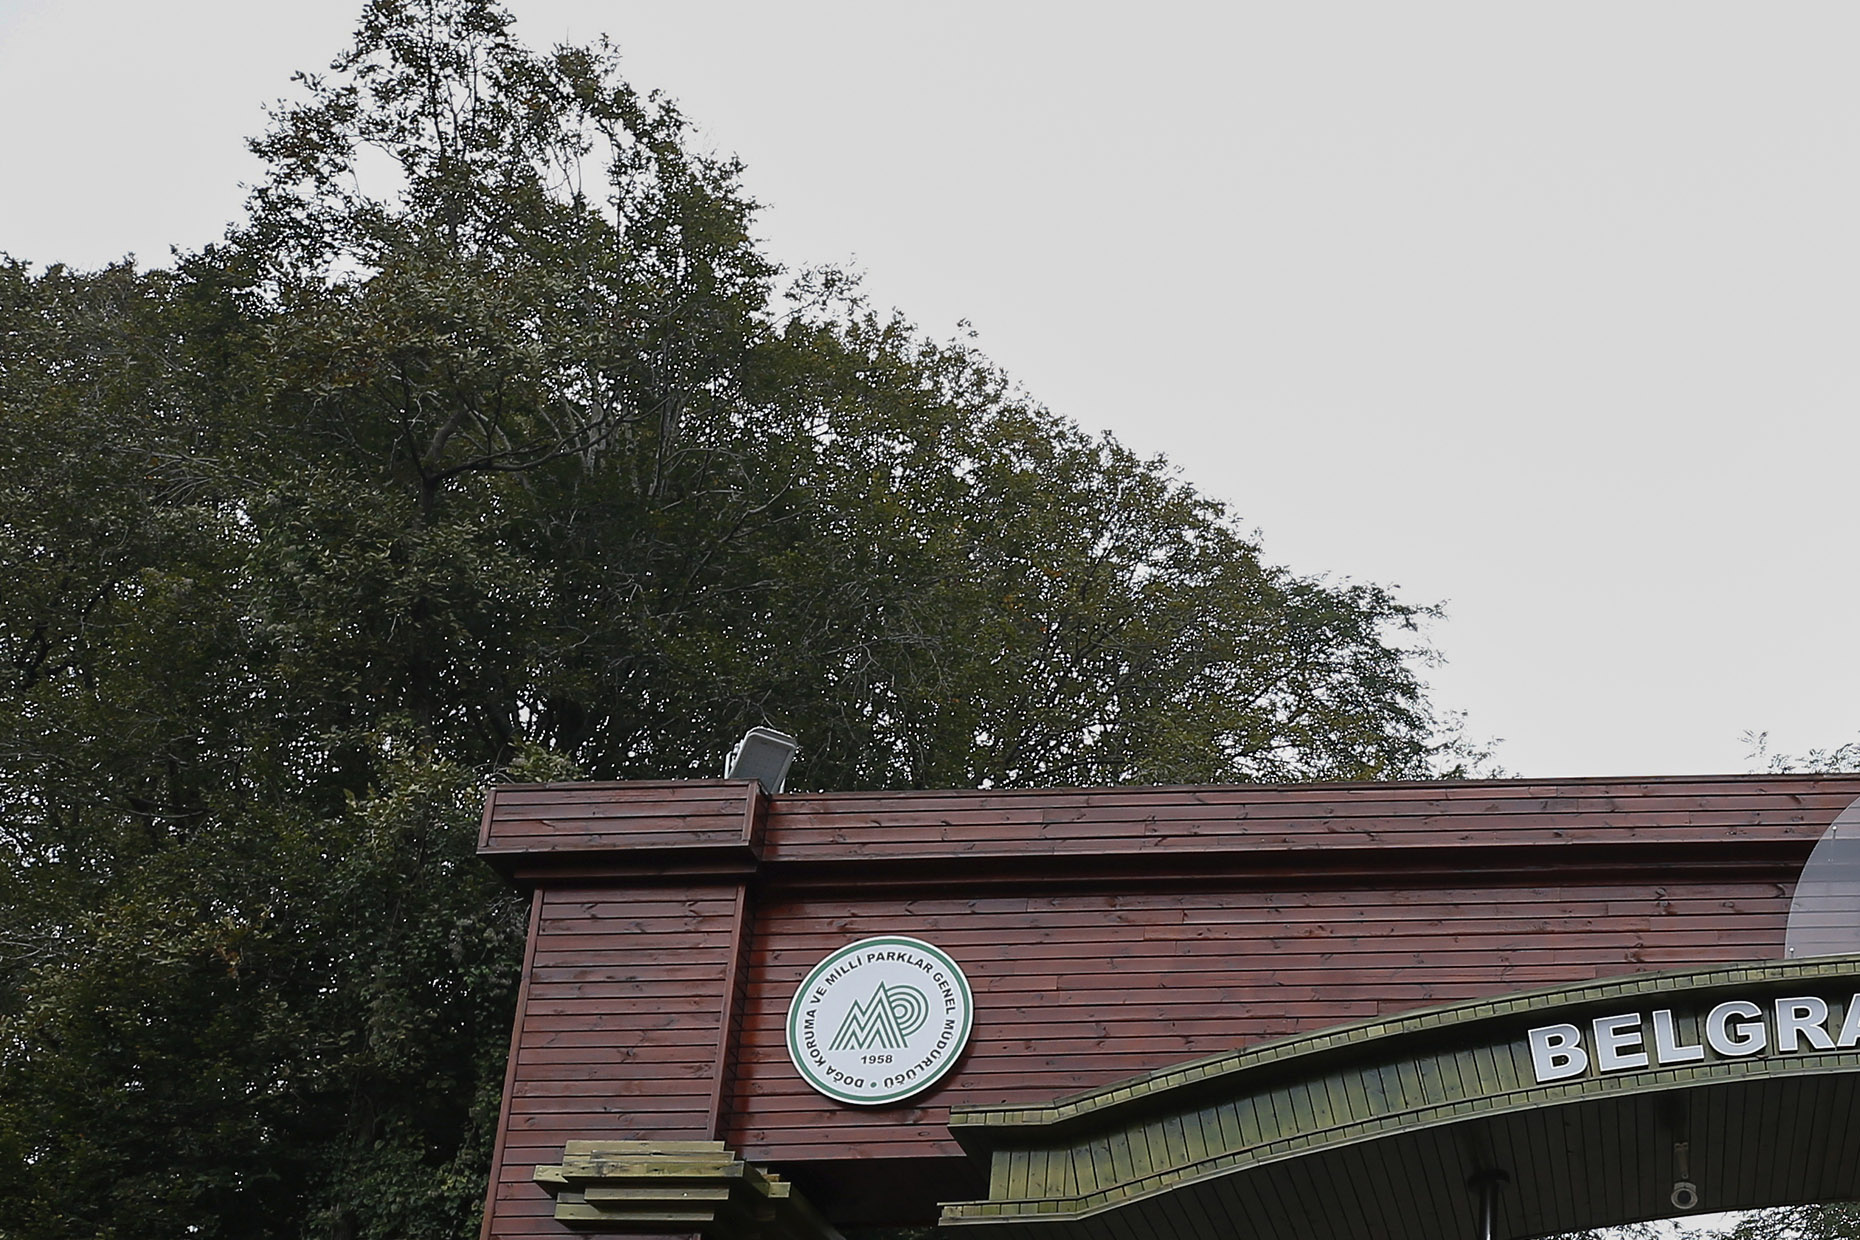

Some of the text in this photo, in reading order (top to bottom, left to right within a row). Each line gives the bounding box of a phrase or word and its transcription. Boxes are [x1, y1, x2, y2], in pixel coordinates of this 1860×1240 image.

[804, 951, 957, 1089] DOĞA KORUMA VE MİLLİ PARKLAR GENEL MÜDÜRLÜĞÜ
[860, 1054, 893, 1065] 1958
